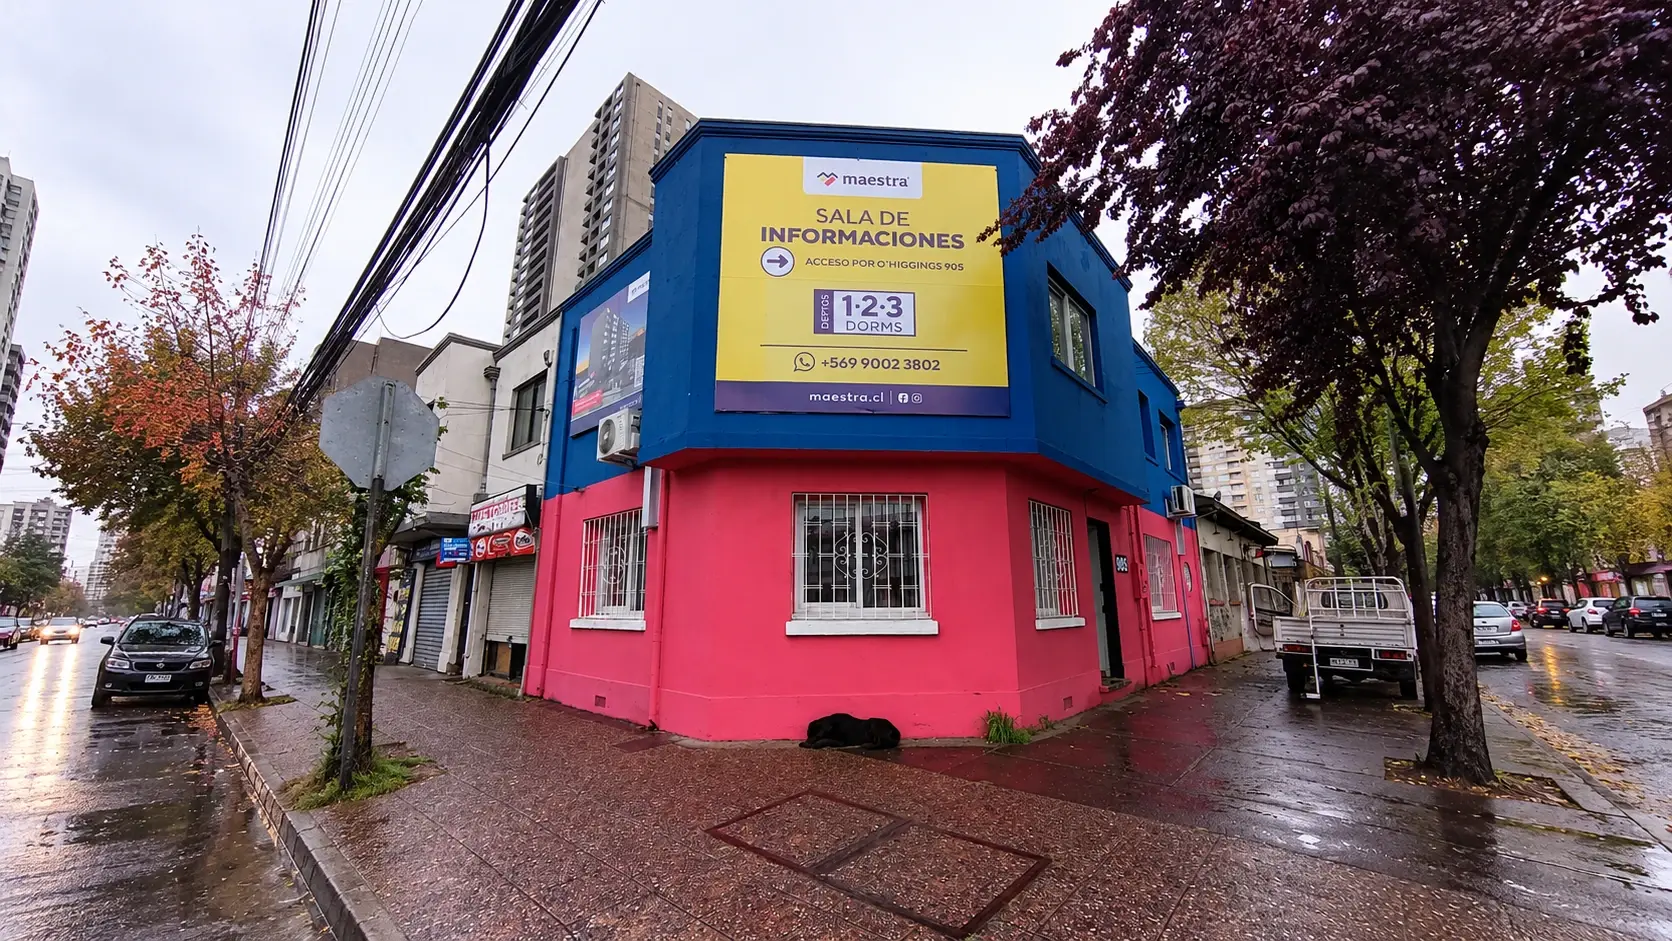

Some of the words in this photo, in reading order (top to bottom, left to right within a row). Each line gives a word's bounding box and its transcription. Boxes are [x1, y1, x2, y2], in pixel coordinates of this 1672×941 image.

[843, 174, 909, 187] maestra
[816, 208, 874, 225] SALA
[880, 211, 910, 227] DE
[761, 226, 965, 249] INFORMACIONES
[805, 257, 850, 267] ACCESO
[852, 259, 875, 268] POR
[944, 263, 964, 271] 905
[821, 294, 830, 329] DEPTOS
[846, 321, 903, 333] DORMS
[821, 357, 858, 369] +569
[860, 358, 900, 370] 9002
[903, 359, 941, 371] 3802
[809, 392, 884, 402] maestra.cl
